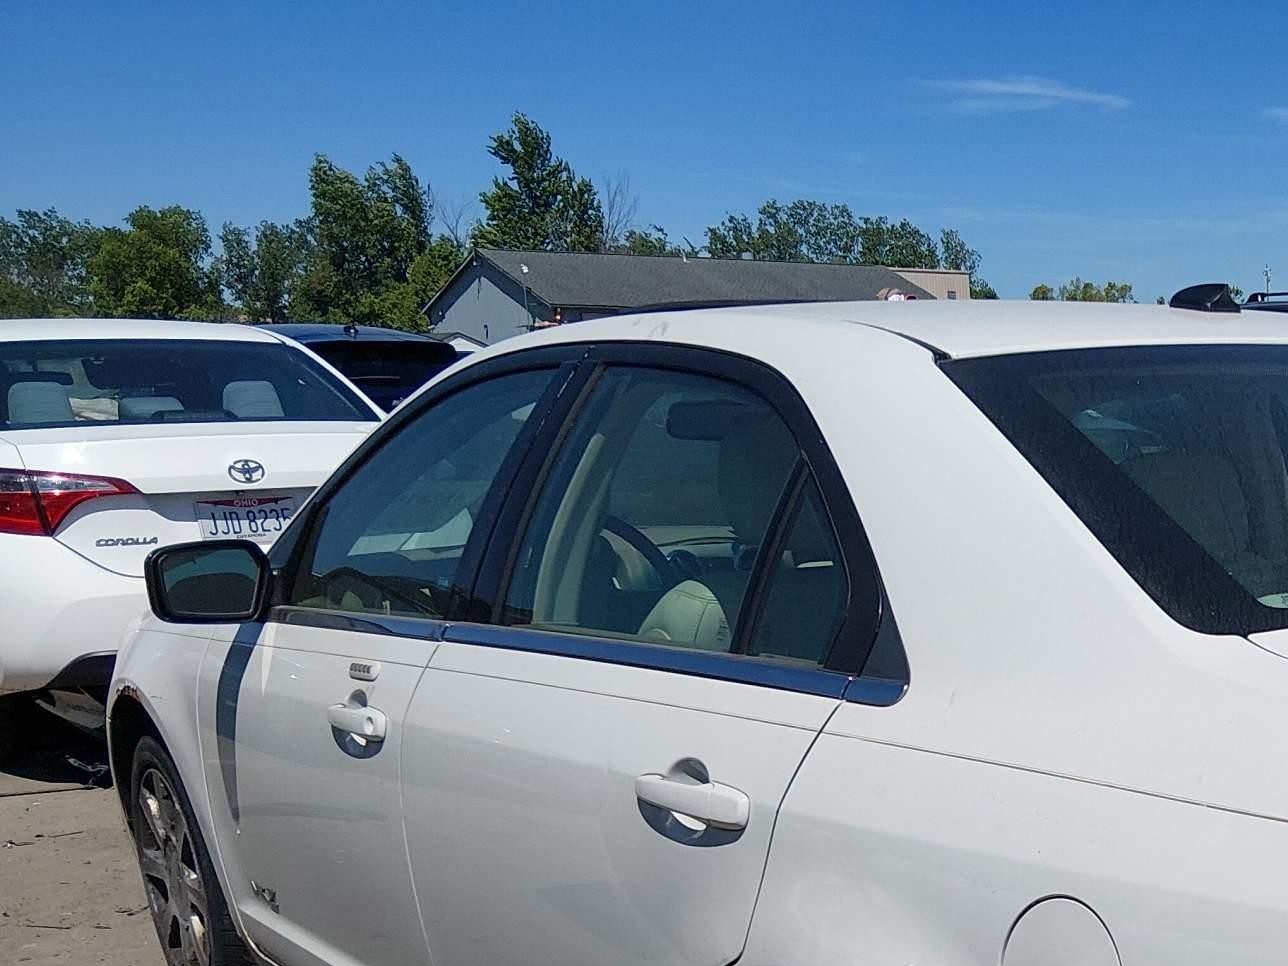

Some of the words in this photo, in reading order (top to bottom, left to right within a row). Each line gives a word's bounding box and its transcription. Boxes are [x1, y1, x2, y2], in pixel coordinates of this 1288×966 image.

[233, 499, 259, 507] OHIO
[209, 511, 242, 535] JJD
[95, 537, 159, 547] COROLLA
